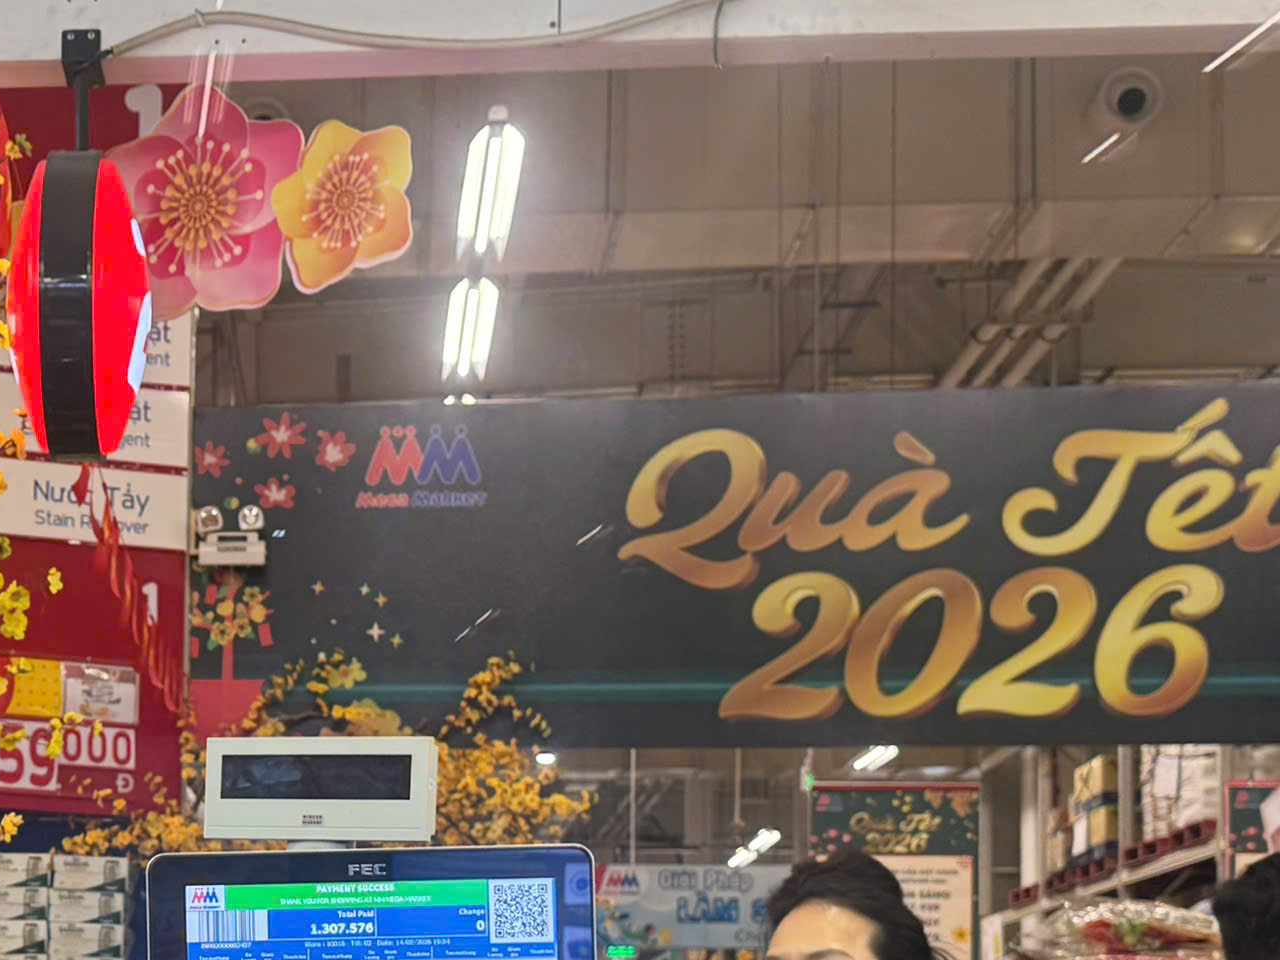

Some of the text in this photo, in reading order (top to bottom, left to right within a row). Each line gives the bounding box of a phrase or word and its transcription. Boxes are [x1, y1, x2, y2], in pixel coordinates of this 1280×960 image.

[618, 398, 1280, 589] Quà Tết
[34, 509, 150, 535] Stain Rover
[719, 564, 1225, 720] 2026
[347, 863, 387, 876] FEC
[315, 883, 396, 894] PAYMENT SUCCESS
[337, 909, 375, 919] Total Paid
[458, 907, 485, 917] Change
[310, 922, 374, 935] 1.307.576
[475, 919, 485, 932] 0
